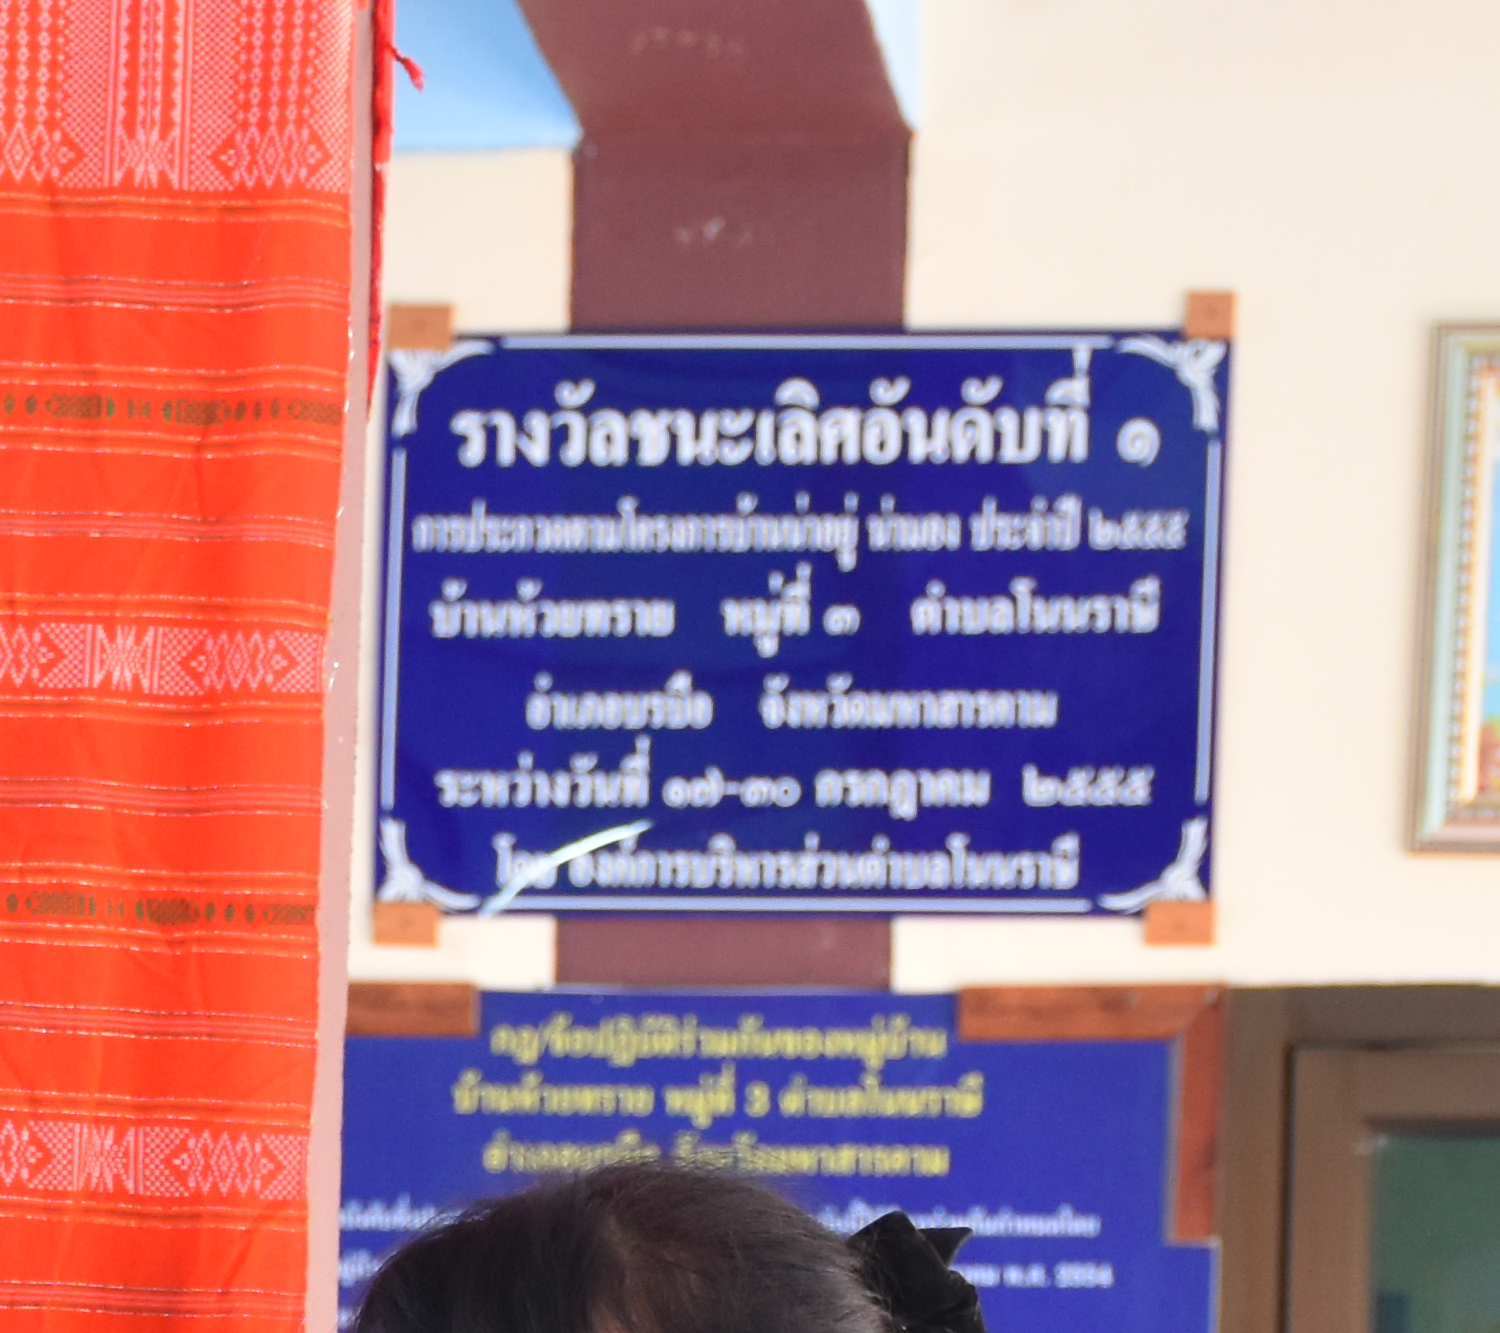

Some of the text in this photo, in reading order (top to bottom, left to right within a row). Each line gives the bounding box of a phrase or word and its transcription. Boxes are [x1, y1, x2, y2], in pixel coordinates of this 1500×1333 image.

[450, 344, 1161, 468] รางวัลชนะเลิศอันดับที่ ๑
[429, 579, 676, 638] บ้านห้วยทราย
[721, 562, 812, 658] หมู่ที่
[525, 670, 1059, 730] อำเภอบรบือ จังหวัดมหาสารคาม
[434, 734, 652, 808] ระหว่างวันที่
[814, 768, 991, 821] กรกฎาคม
